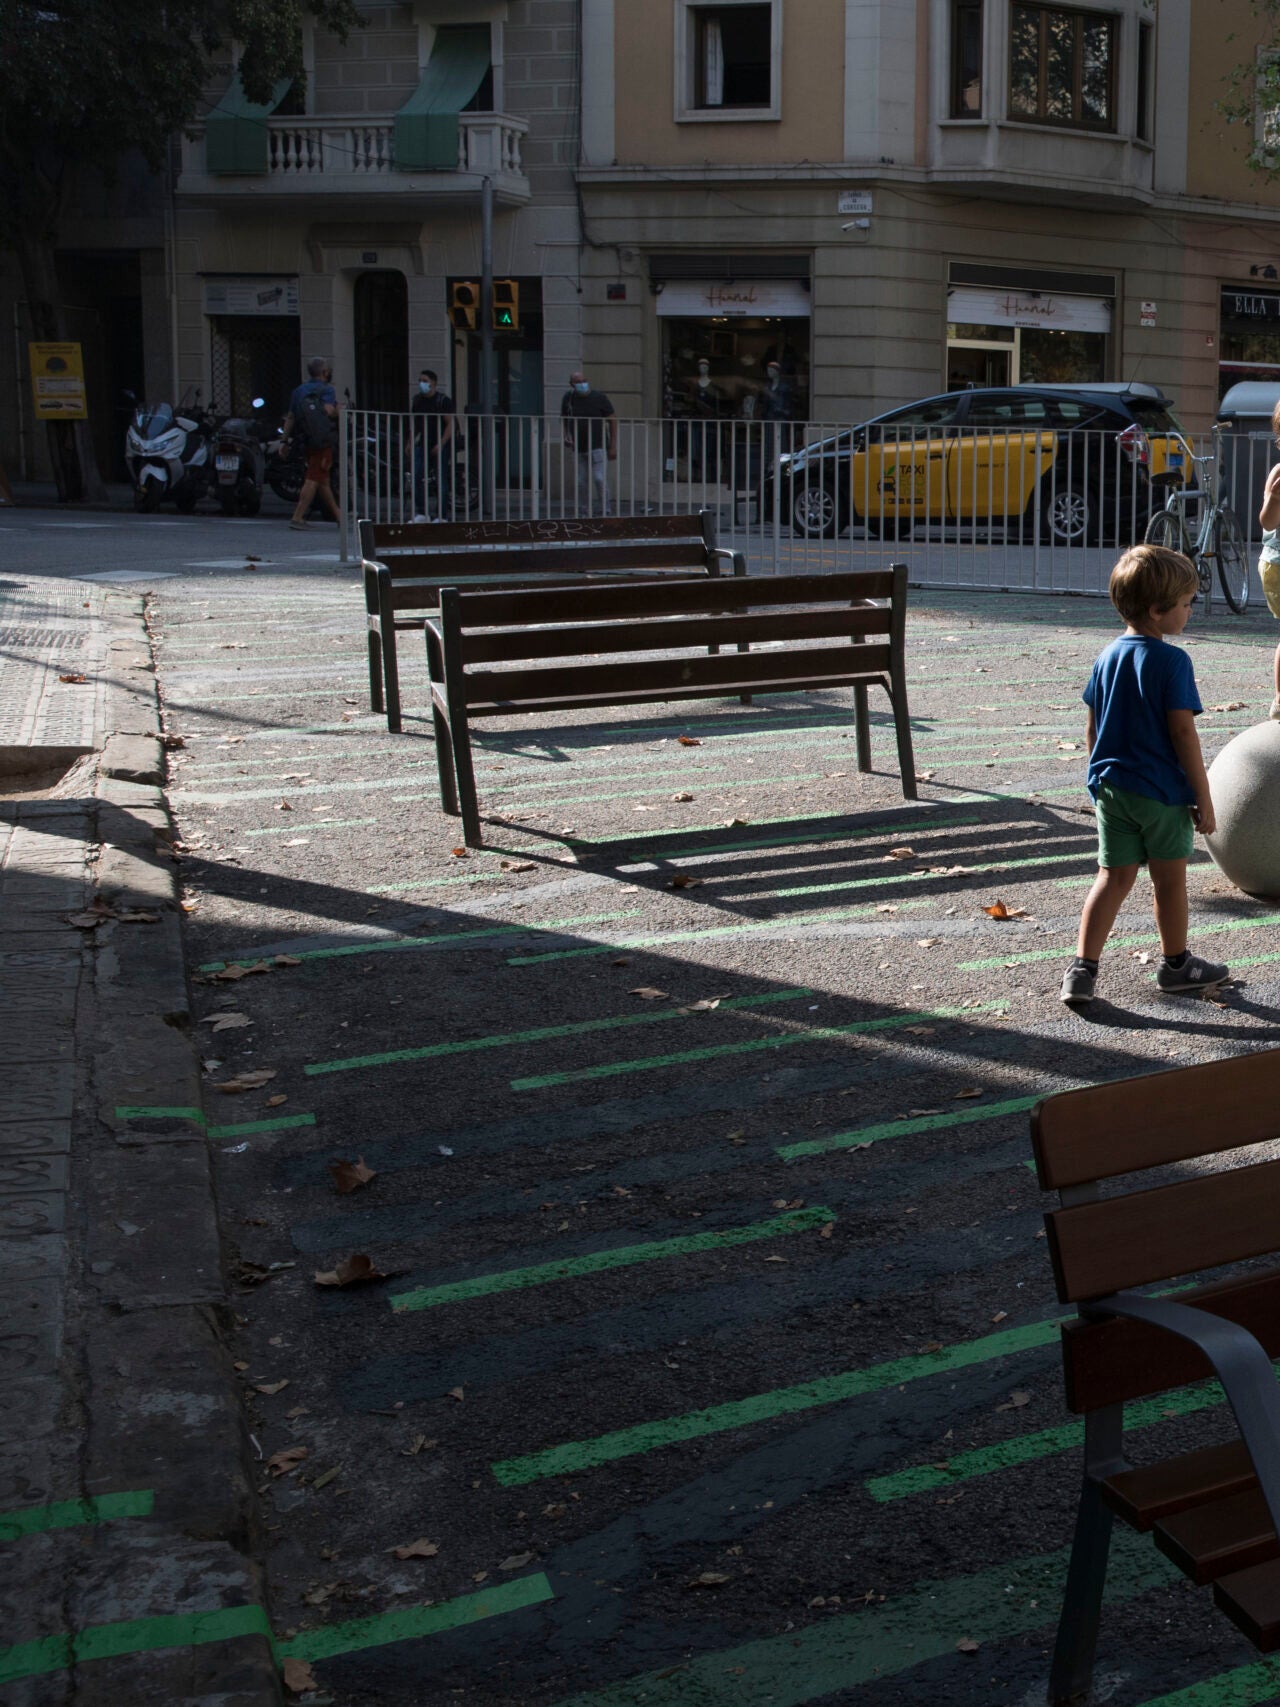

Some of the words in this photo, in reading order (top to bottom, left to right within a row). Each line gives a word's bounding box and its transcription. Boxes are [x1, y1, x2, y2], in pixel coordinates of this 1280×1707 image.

[1235, 296, 1267, 315] ELLA
[899, 464, 925, 475] TAXI
[1190, 967, 1203, 979] N
